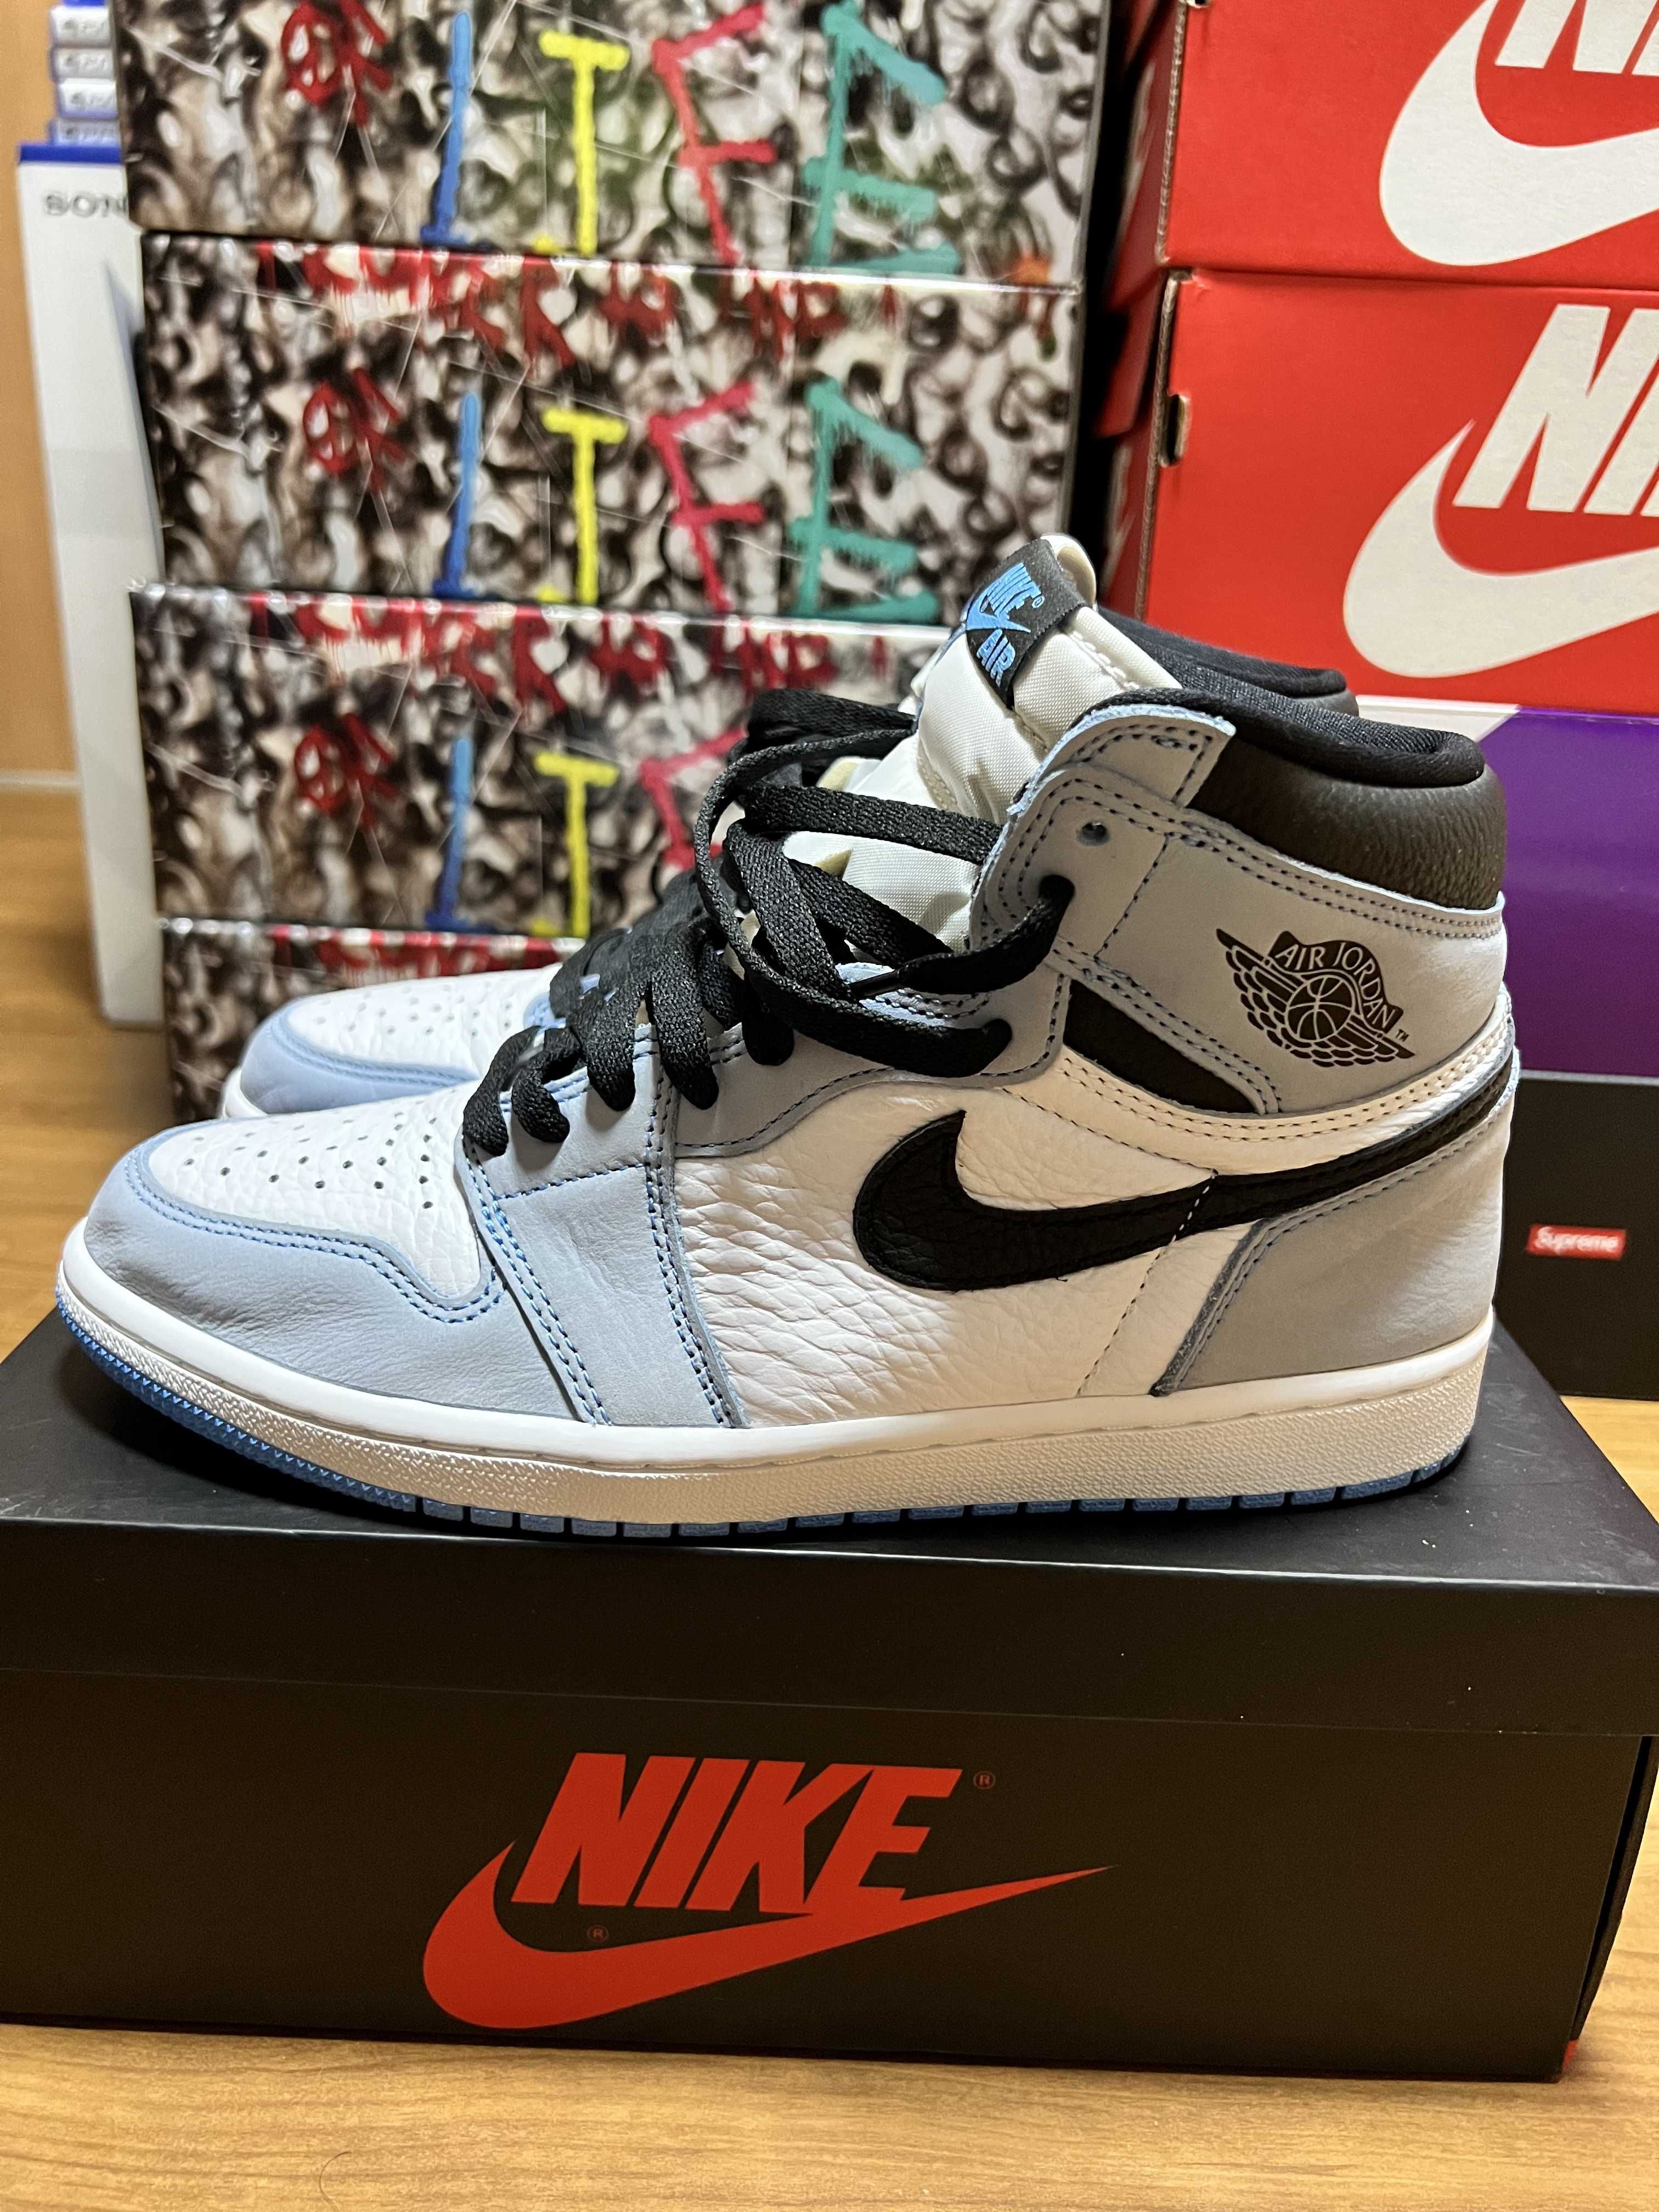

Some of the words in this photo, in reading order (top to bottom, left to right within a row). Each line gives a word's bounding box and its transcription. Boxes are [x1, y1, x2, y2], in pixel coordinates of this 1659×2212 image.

[45, 191, 128, 218] SON
[1452, 303, 1659, 517] NI
[976, 629, 1016, 686] AIR
[1274, 944, 1326, 970] AIR
[1331, 942, 1396, 1028] JORDAN
[1534, 1226, 1620, 1256] Supreme
[511, 1752, 963, 1915] NIKE
